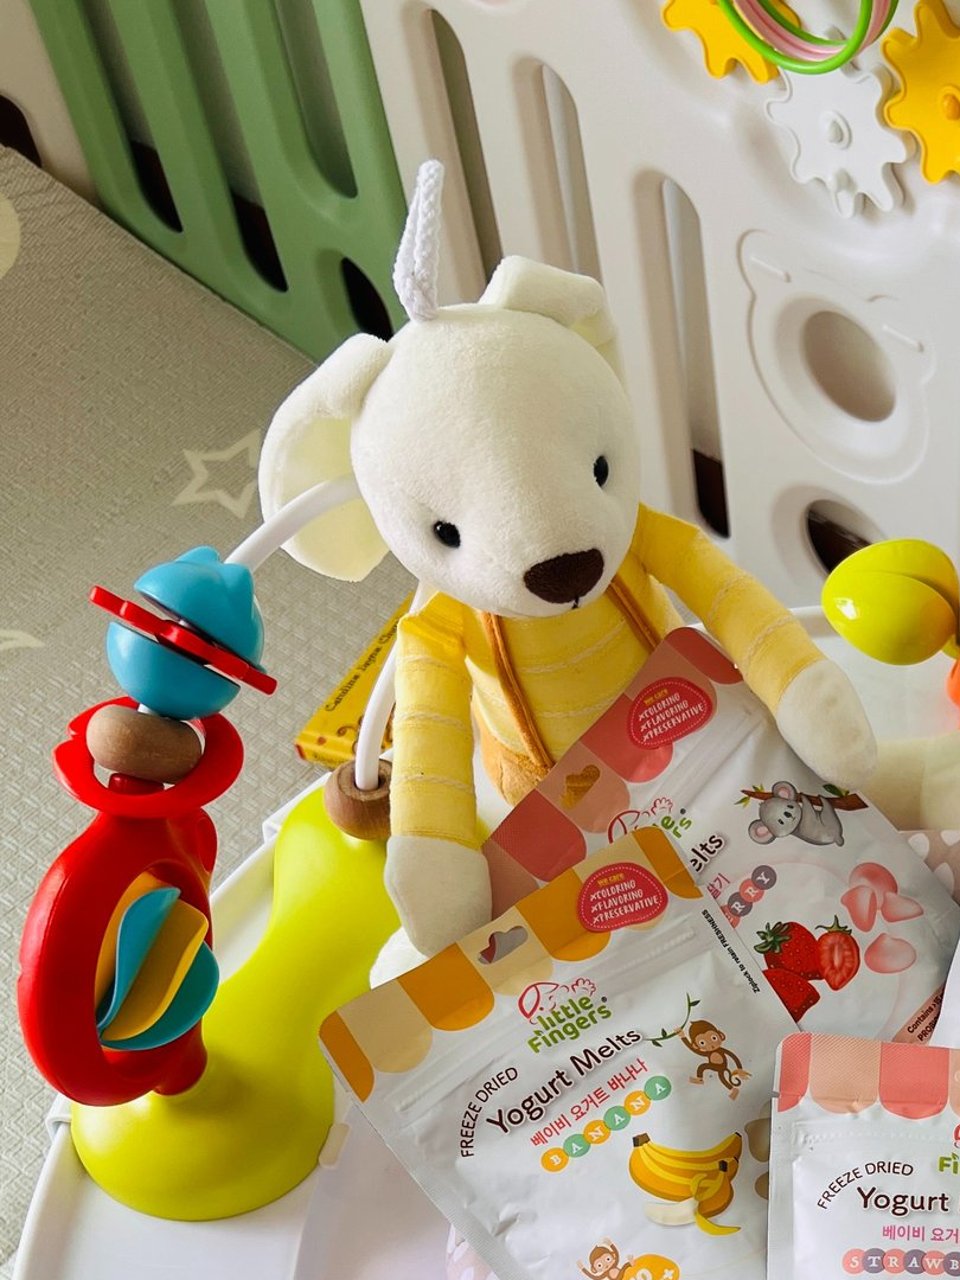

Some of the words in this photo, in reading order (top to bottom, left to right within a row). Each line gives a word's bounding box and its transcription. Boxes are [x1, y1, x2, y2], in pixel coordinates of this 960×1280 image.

[690, 834, 723, 872] elts
[527, 1004, 612, 1054] Fingers
[537, 996, 594, 1031] little
[486, 1069, 573, 1134] Yogurt
[569, 1029, 642, 1076] Melts
[530, 1113, 572, 1148] 베이비
[570, 1087, 611, 1121] 요거트
[607, 1057, 649, 1091] 바나나
[460, 1101, 483, 1158] FREEZE
[475, 1066, 519, 1103] DRIED
[548, 1081, 668, 1168] BANANA
[817, 1168, 862, 1209] FREEZE
[865, 1161, 914, 1176] DRIED
[857, 1187, 949, 1216] Yogurt
[882, 1225, 925, 1241] 베이비
